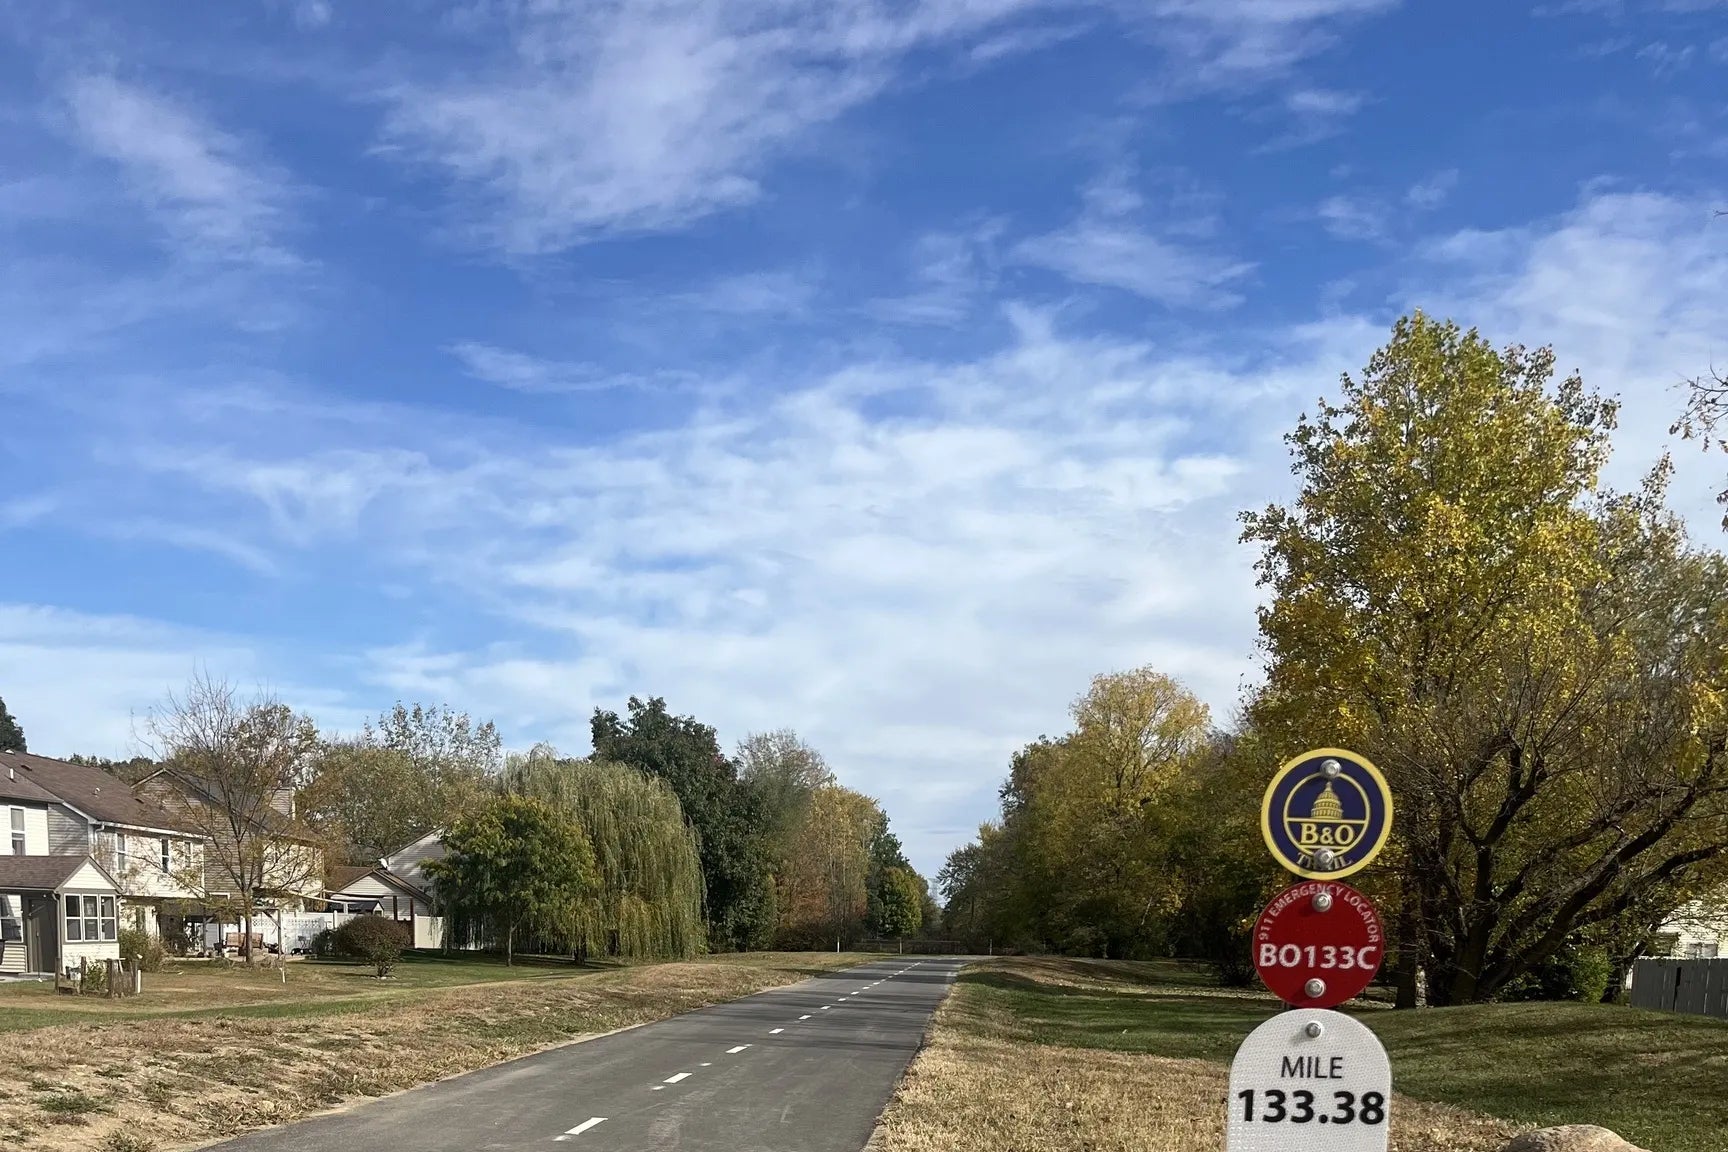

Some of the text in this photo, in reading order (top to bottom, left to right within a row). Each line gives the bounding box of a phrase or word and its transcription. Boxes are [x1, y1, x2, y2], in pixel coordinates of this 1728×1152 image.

[1300, 823, 1354, 844] B&O
[1296, 851, 1352, 869] TIL
[1258, 883, 1379, 942] 911 EMERGENCY LOCATOR
[1259, 943, 1377, 970] BO133C
[1280, 1056, 1343, 1079] MILE
[1238, 1089, 1385, 1125] 133.38
